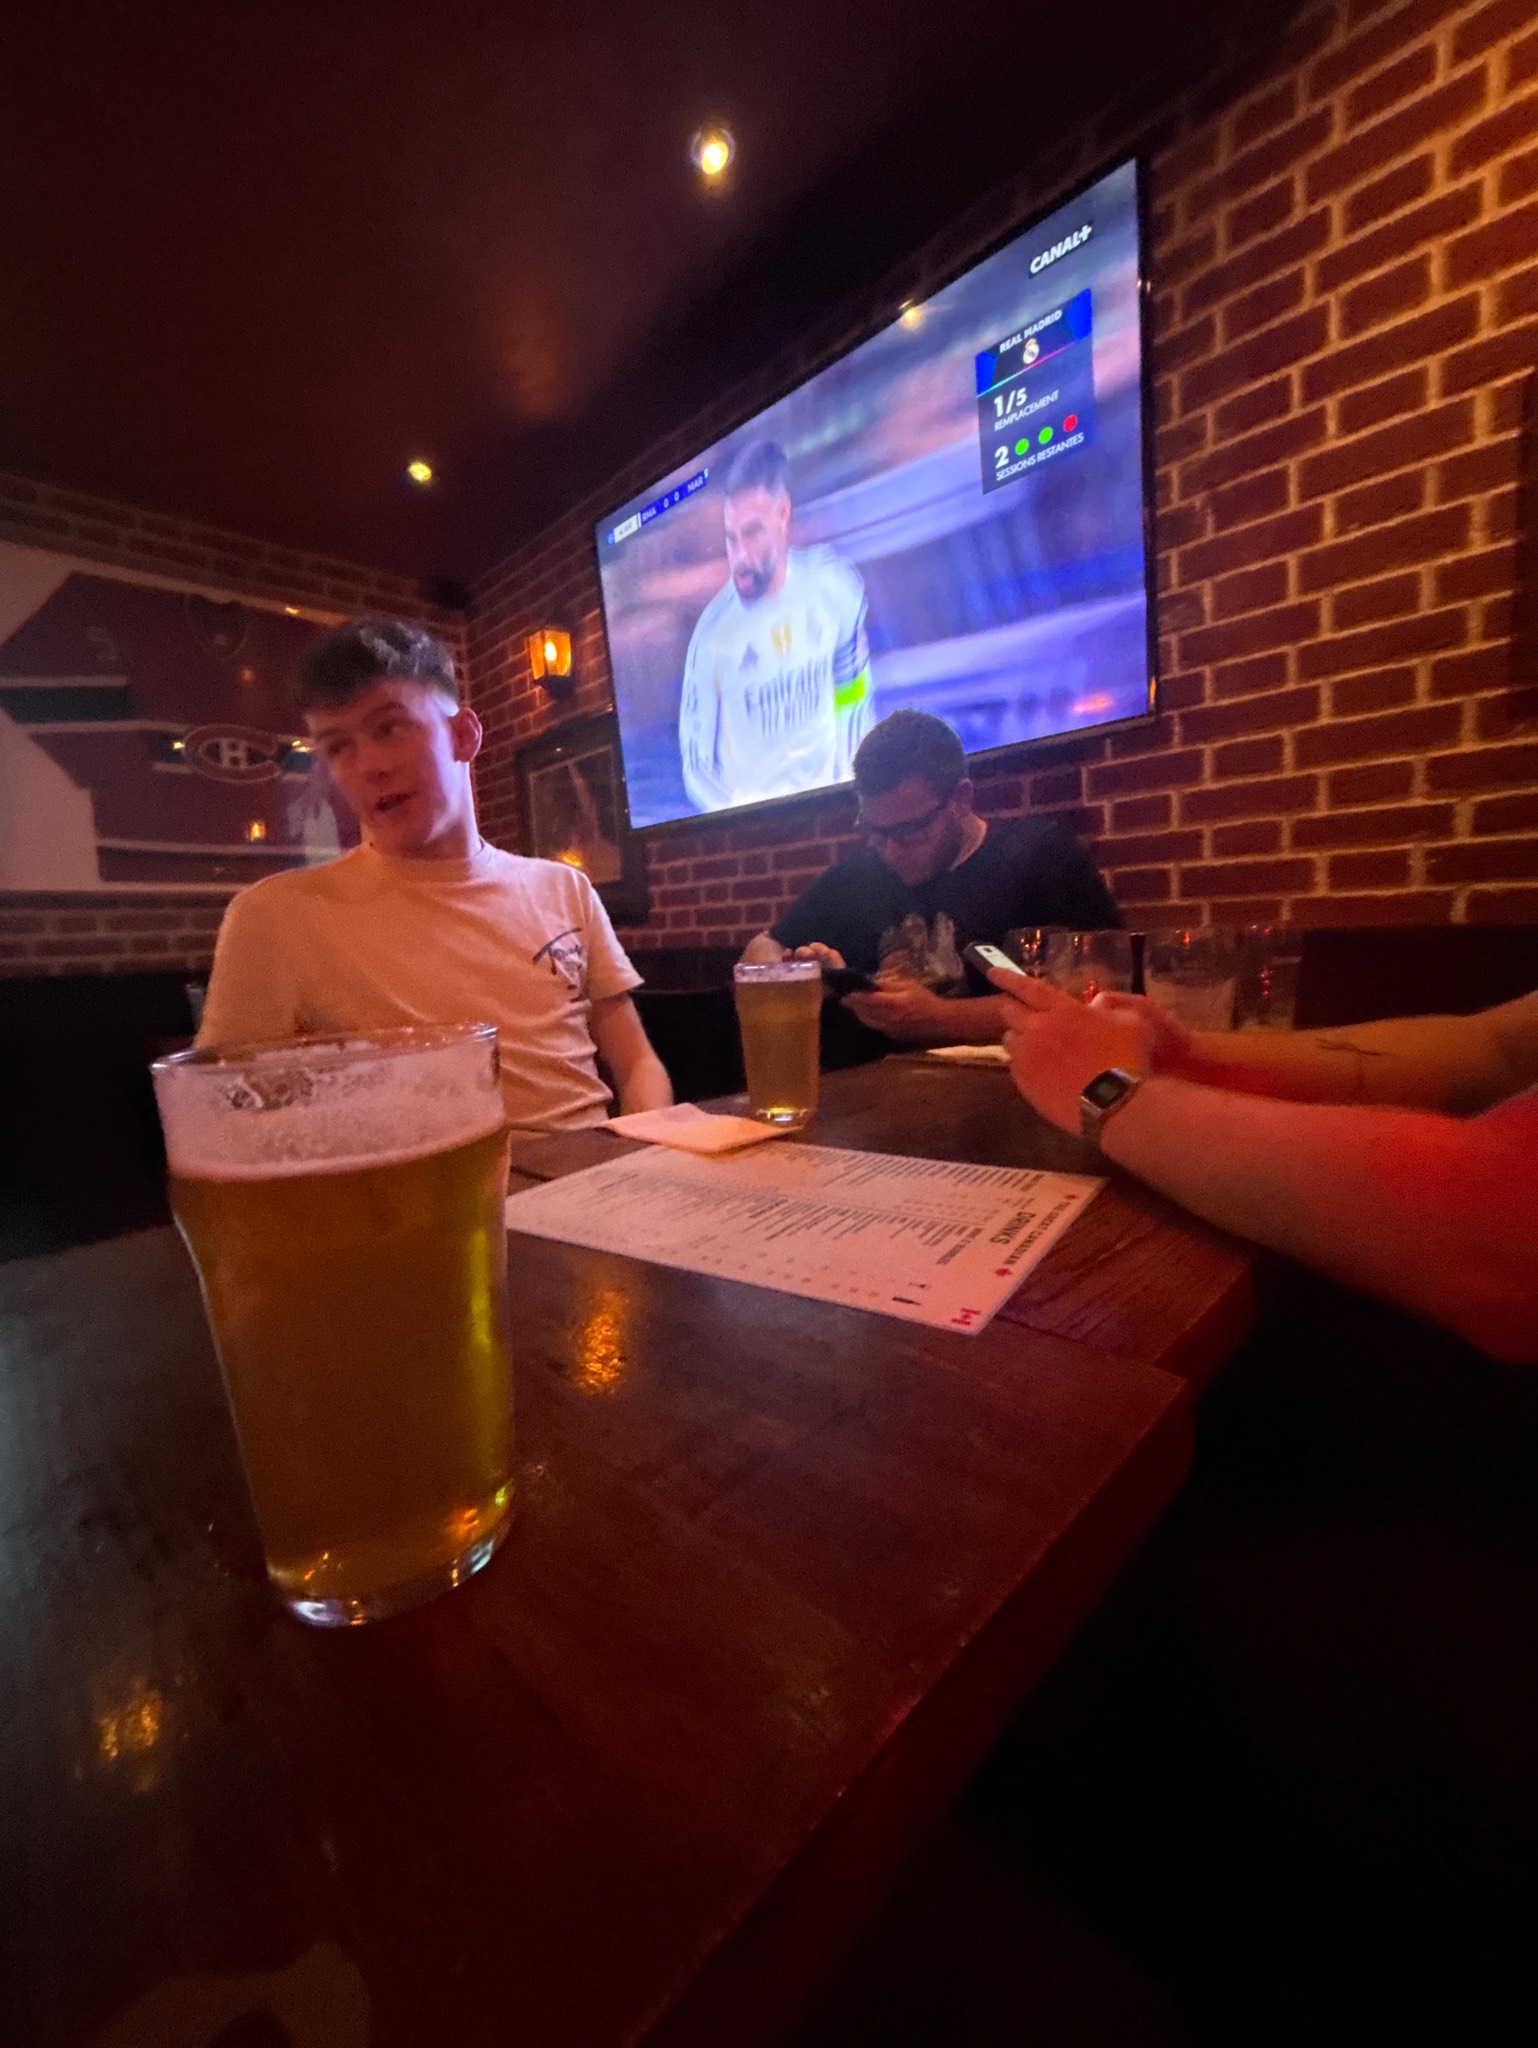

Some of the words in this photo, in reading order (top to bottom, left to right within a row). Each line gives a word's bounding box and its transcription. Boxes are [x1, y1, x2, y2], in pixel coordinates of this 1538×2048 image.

[1029, 224, 1093, 274] CANAL+
[1000, 333, 1023, 353] REAL
[1023, 309, 1063, 338] MADRID
[993, 387, 1028, 418] 1/5
[994, 389, 1060, 432] REMPLACEMENT
[994, 445, 1010, 469] 2
[996, 455, 1037, 481] SESSIONS
[1036, 432, 1085, 463] RESTANTES
[989, 1211, 1037, 1245] DRINKS
[1003, 1230, 1043, 1265] CANADIAN
